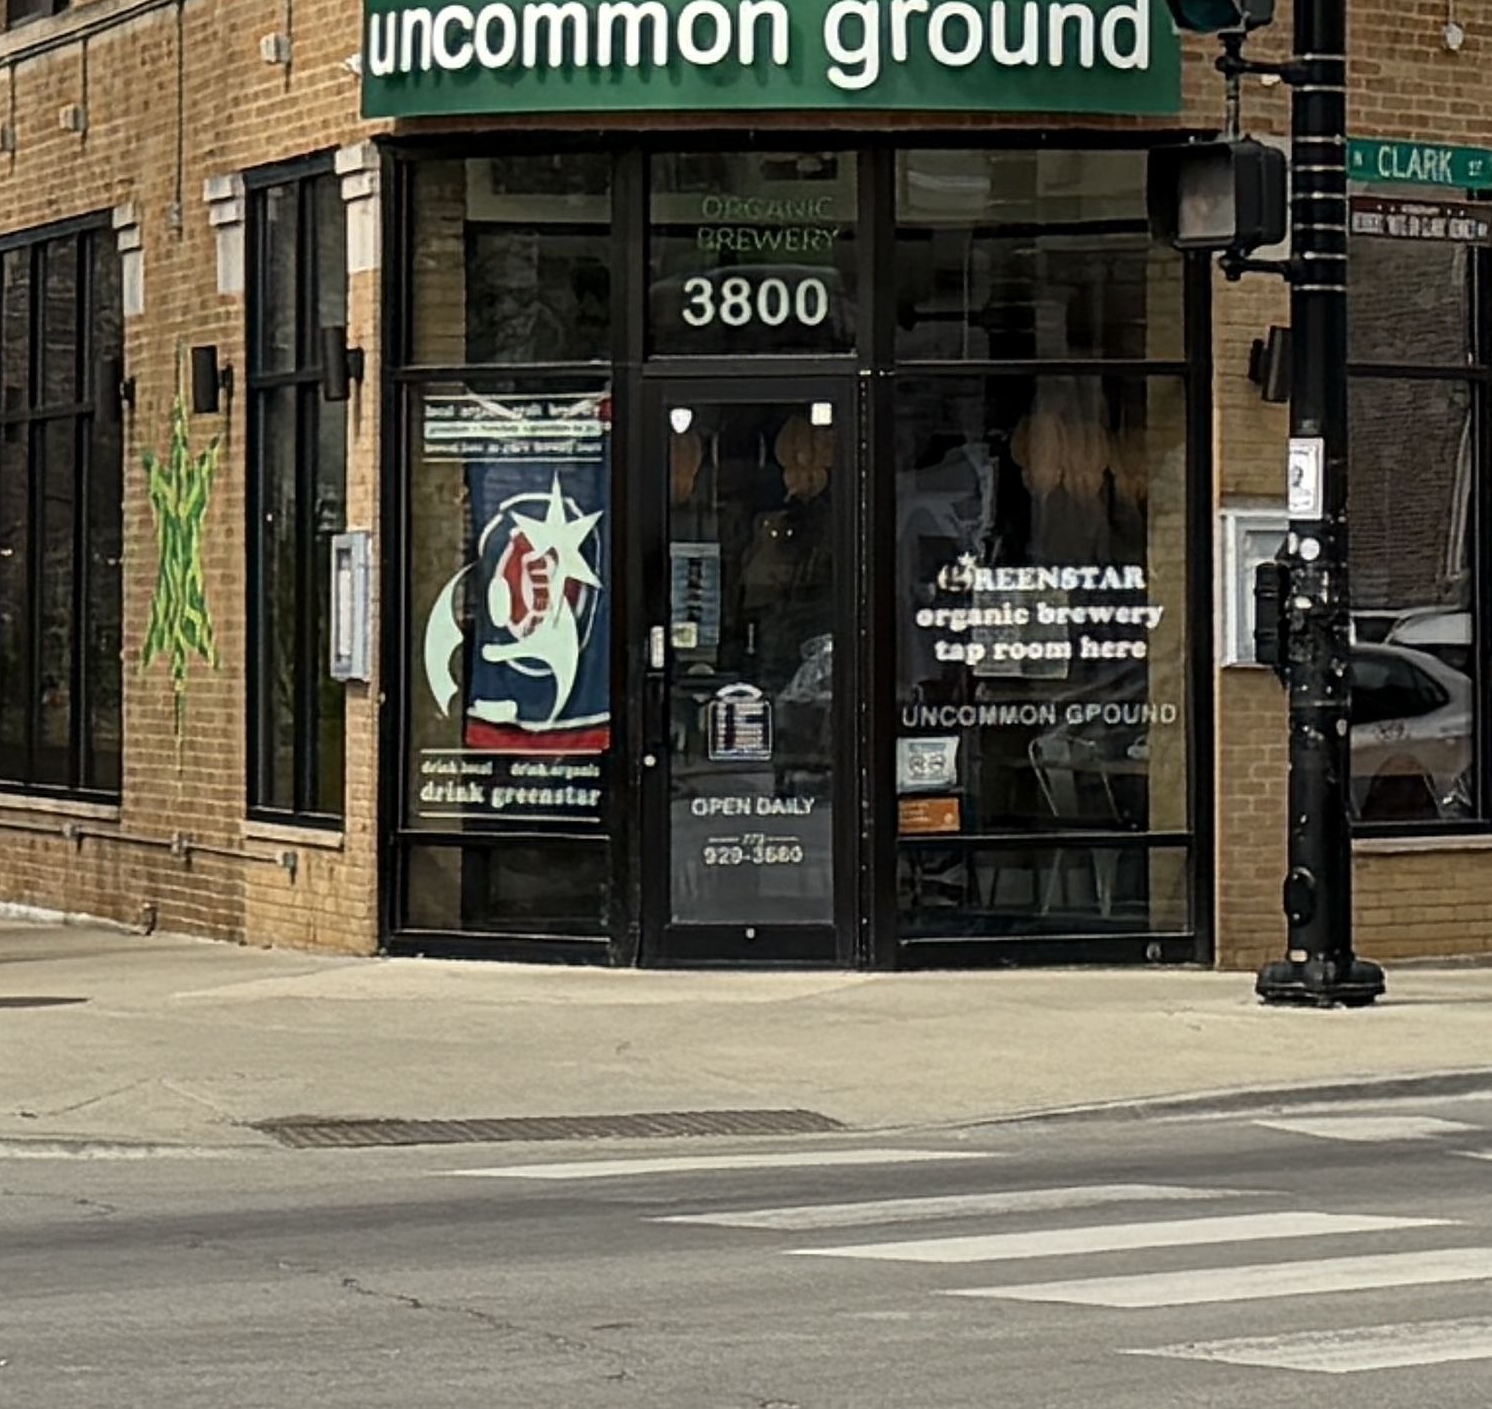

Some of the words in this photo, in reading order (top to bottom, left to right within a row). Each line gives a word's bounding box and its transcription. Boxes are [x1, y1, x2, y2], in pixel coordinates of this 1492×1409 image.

[1378, 145, 1452, 183] CLARK
[702, 196, 832, 220] ORGANIC
[698, 227, 839, 251] BREWERY
[682, 277, 828, 326] 3800
[937, 557, 1146, 591] GREENSTAR
[916, 602, 1029, 631] organic
[1036, 602, 1164, 628] brewery
[934, 639, 986, 666] tap
[993, 641, 1072, 660] room
[1080, 635, 1147, 659] here
[902, 705, 1056, 727] UNCOMMON
[420, 781, 485, 803] drink
[491, 785, 601, 808] greenstar
[691, 797, 751, 815] OPEN
[757, 797, 815, 814] DAILY
